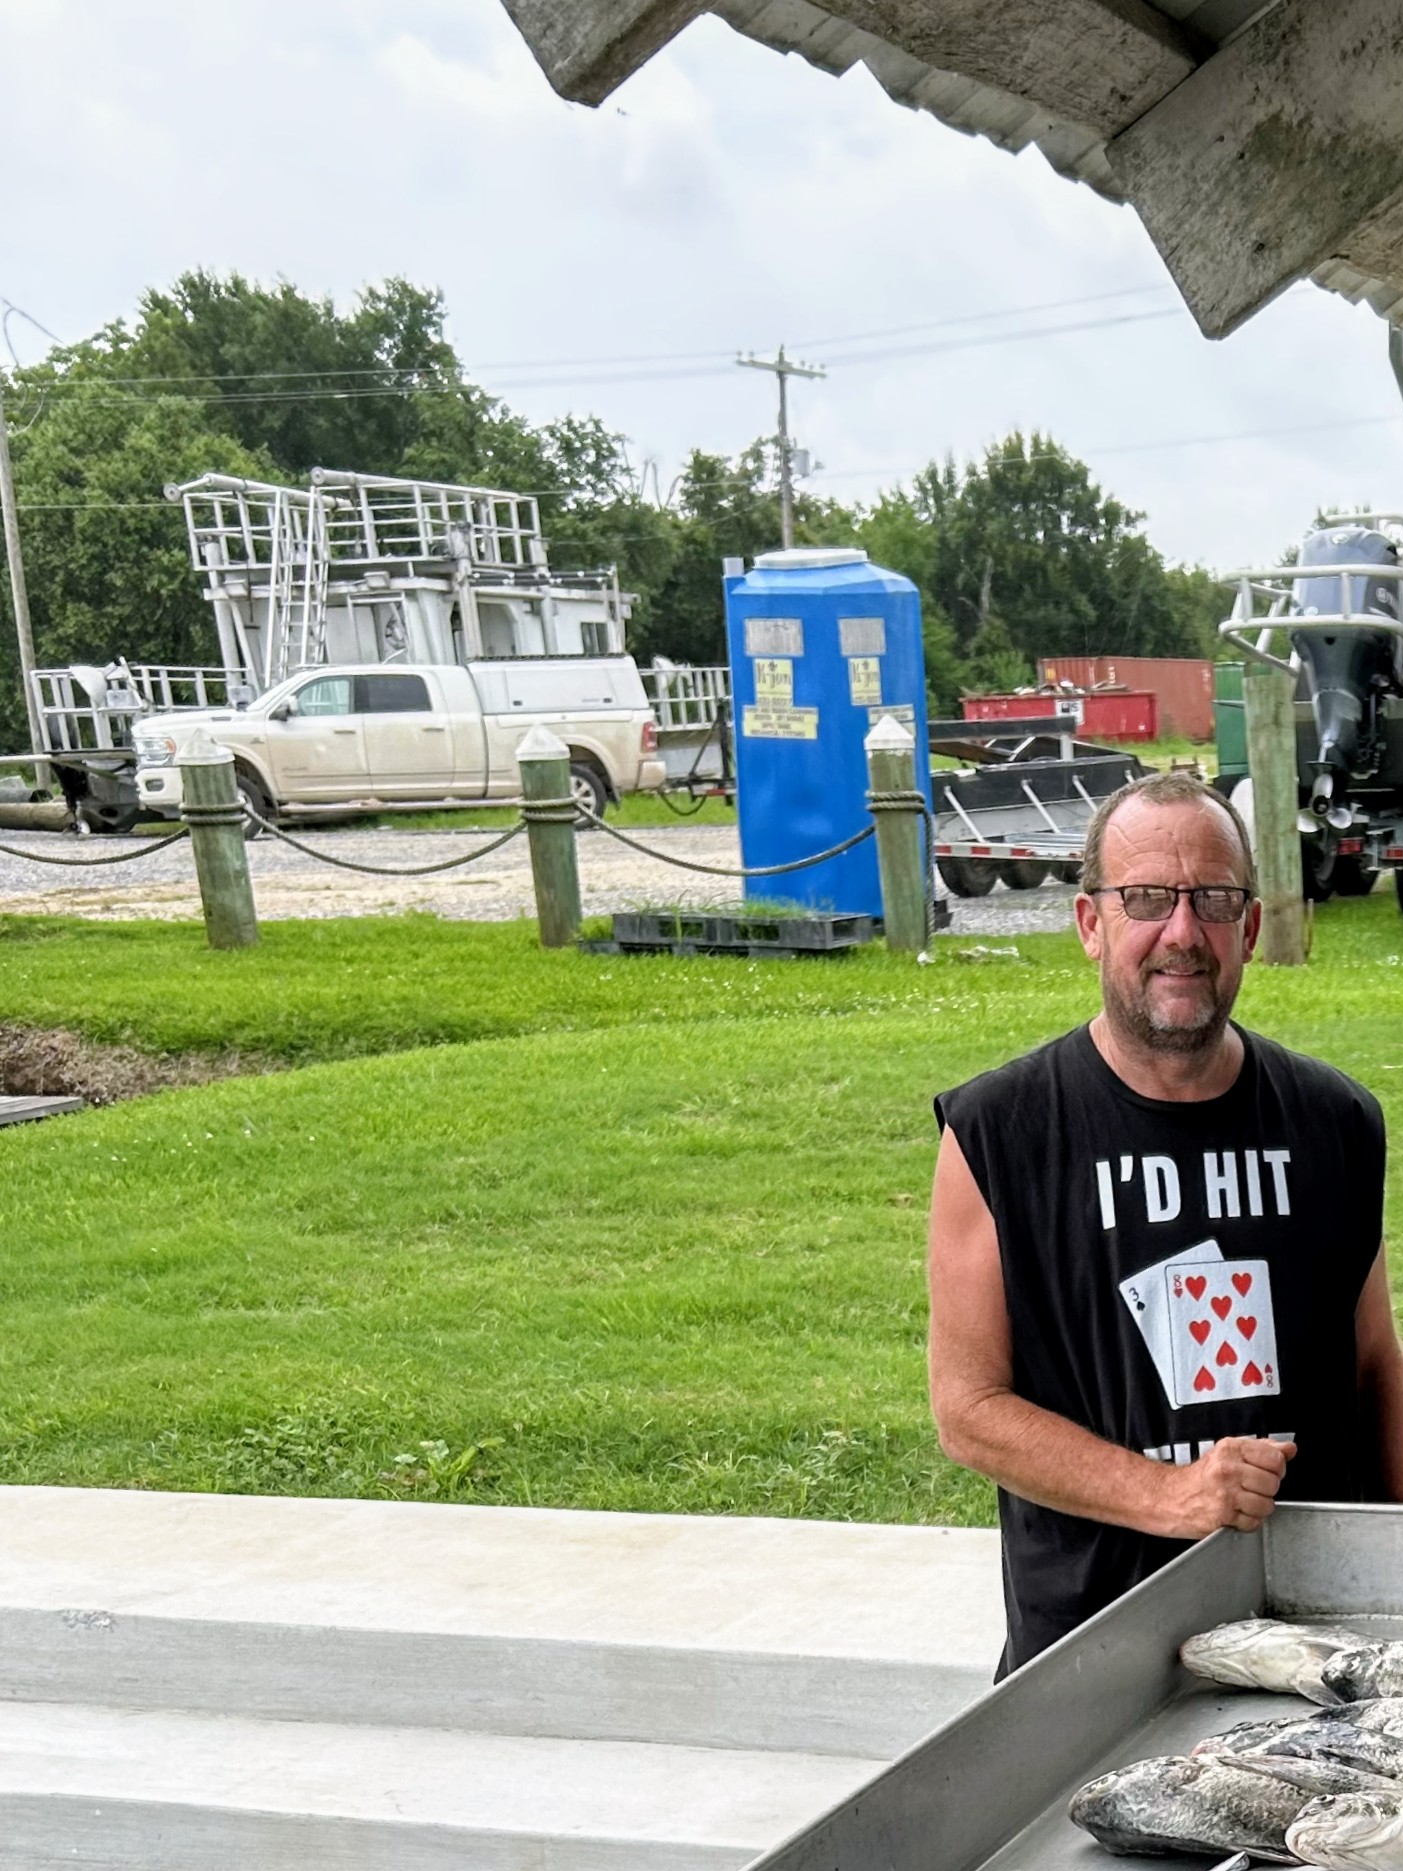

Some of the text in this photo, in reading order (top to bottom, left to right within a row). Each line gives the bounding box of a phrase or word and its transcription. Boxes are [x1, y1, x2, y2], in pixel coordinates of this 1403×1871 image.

[1096, 1149, 1291, 1230] I'D HIT
[1174, 1274, 1182, 1288] 8
[1129, 1287, 1139, 1302] 3
[1266, 1374, 1273, 1388] 8
